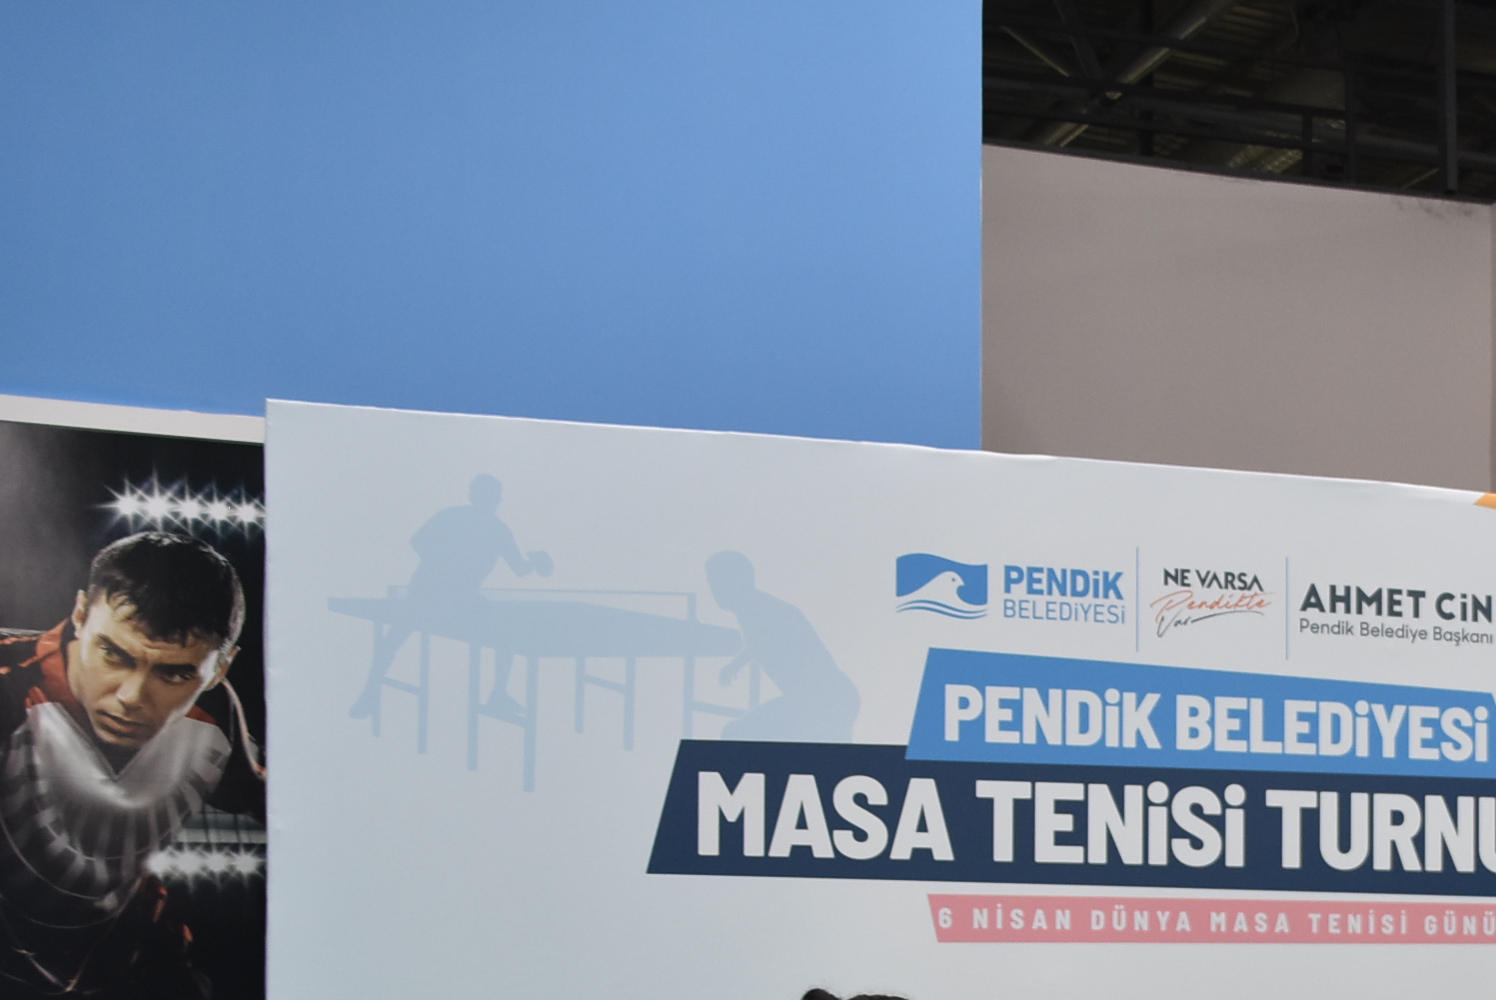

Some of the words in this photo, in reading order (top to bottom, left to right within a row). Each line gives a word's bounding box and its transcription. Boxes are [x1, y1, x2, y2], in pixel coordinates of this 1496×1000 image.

[1163, 568, 1191, 588] NE
[1195, 570, 1264, 592] VARSA
[1299, 583, 1426, 619] AHMET
[1299, 618, 1354, 636] Pendik
[1359, 622, 1428, 644] Belediye
[698, 770, 954, 861] MASA
[938, 907, 953, 929] 6
[1090, 904, 1192, 932] DÜNYA
[1210, 911, 1291, 933] MASA
[1424, 911, 1496, 936] GÜNÜ
